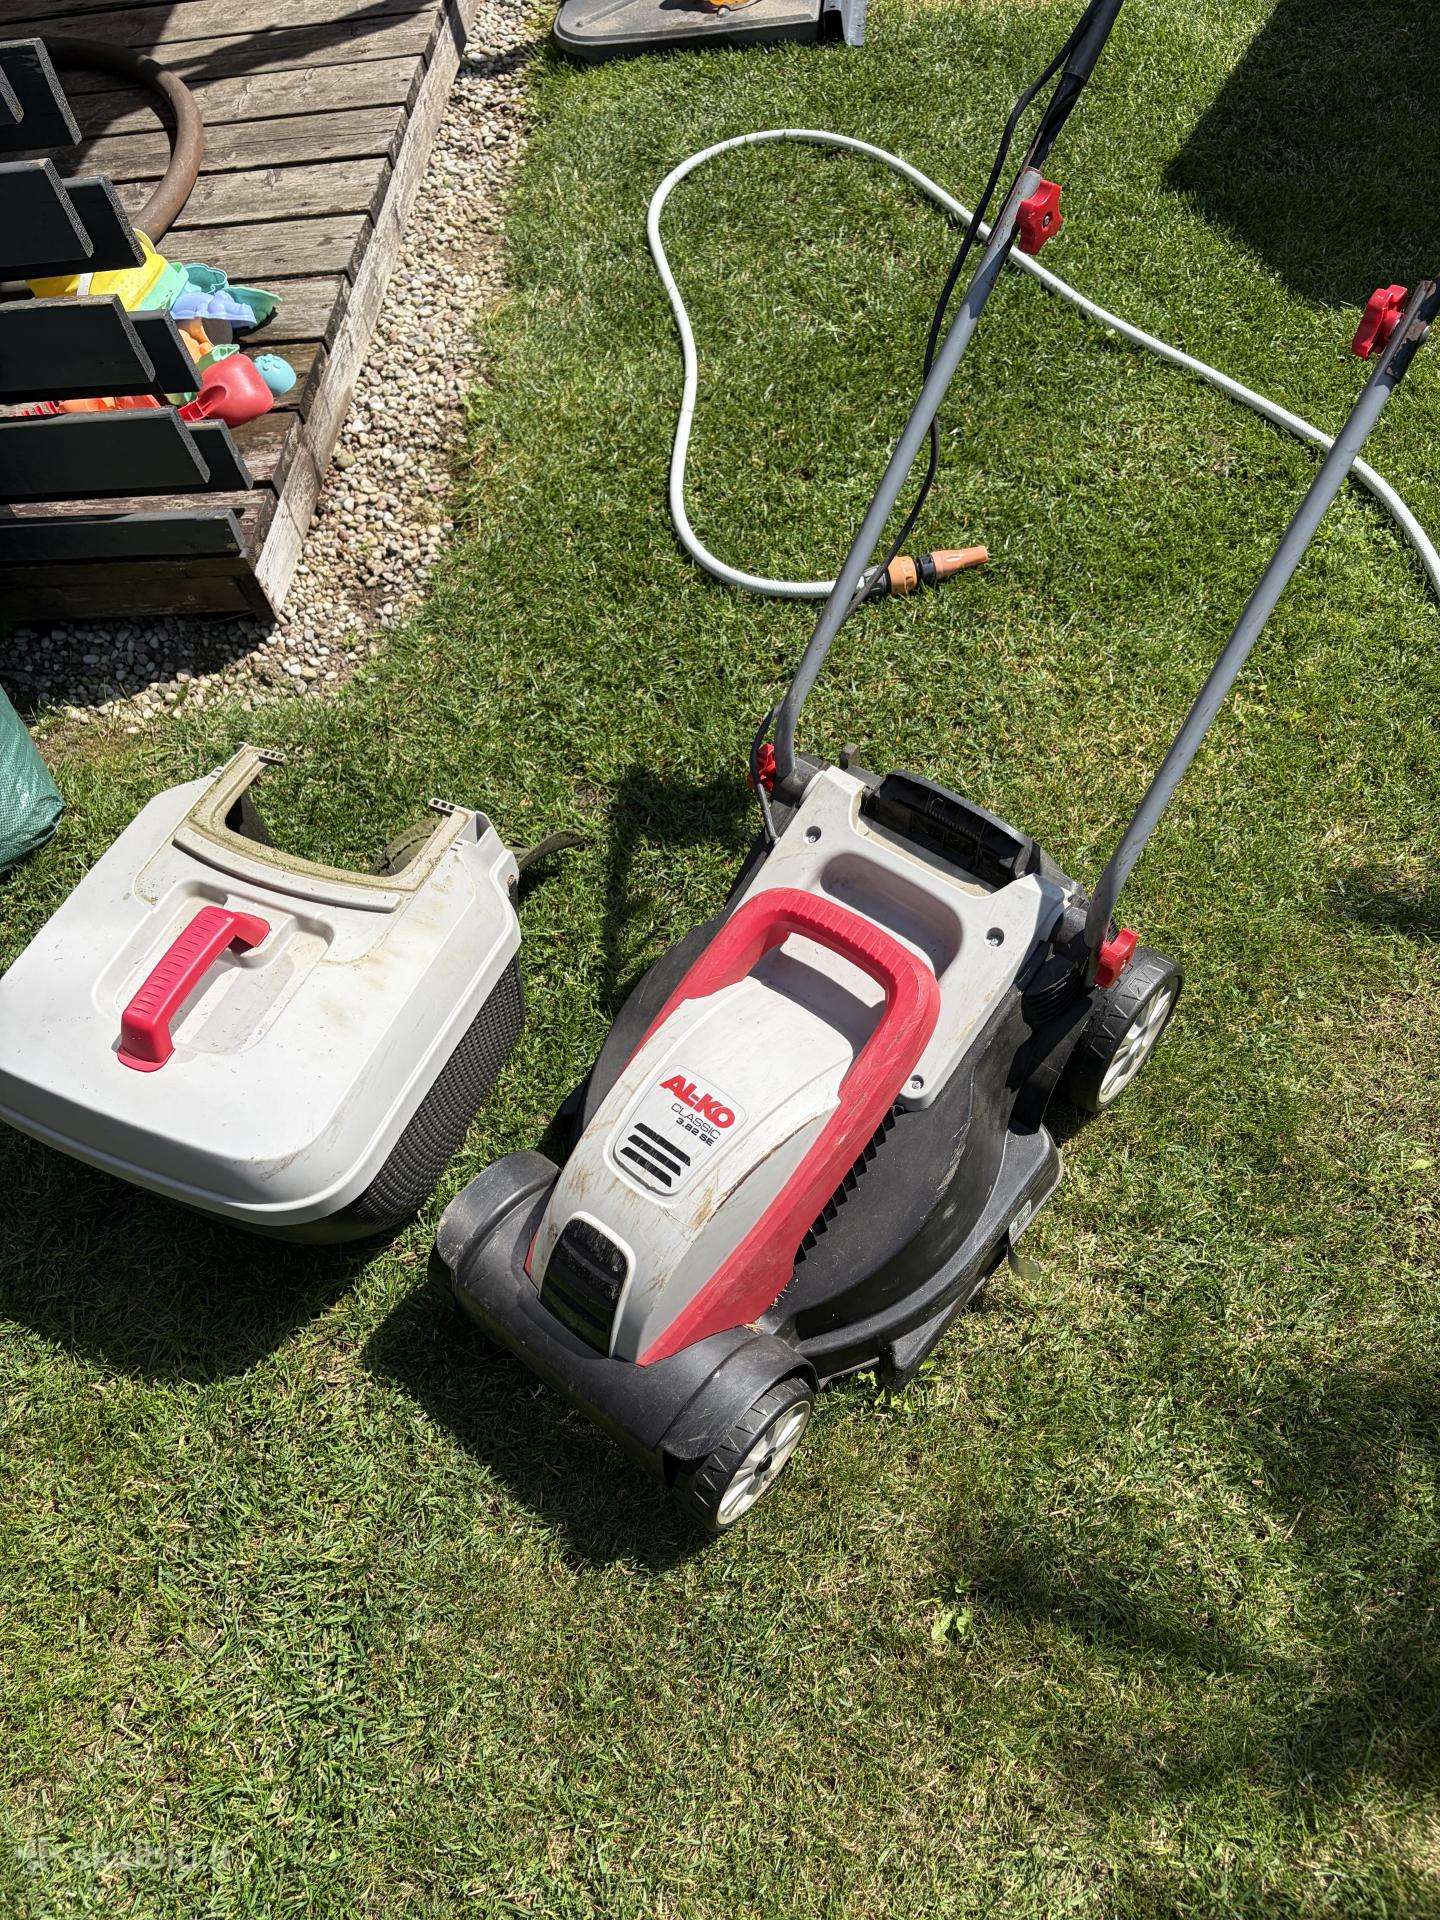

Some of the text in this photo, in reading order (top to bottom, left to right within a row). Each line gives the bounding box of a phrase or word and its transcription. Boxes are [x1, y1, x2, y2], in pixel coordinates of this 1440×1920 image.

[659, 1074, 736, 1129] AL-KO
[671, 1102, 721, 1140] CLASSIC
[675, 1117, 715, 1147] 3.82 SE
